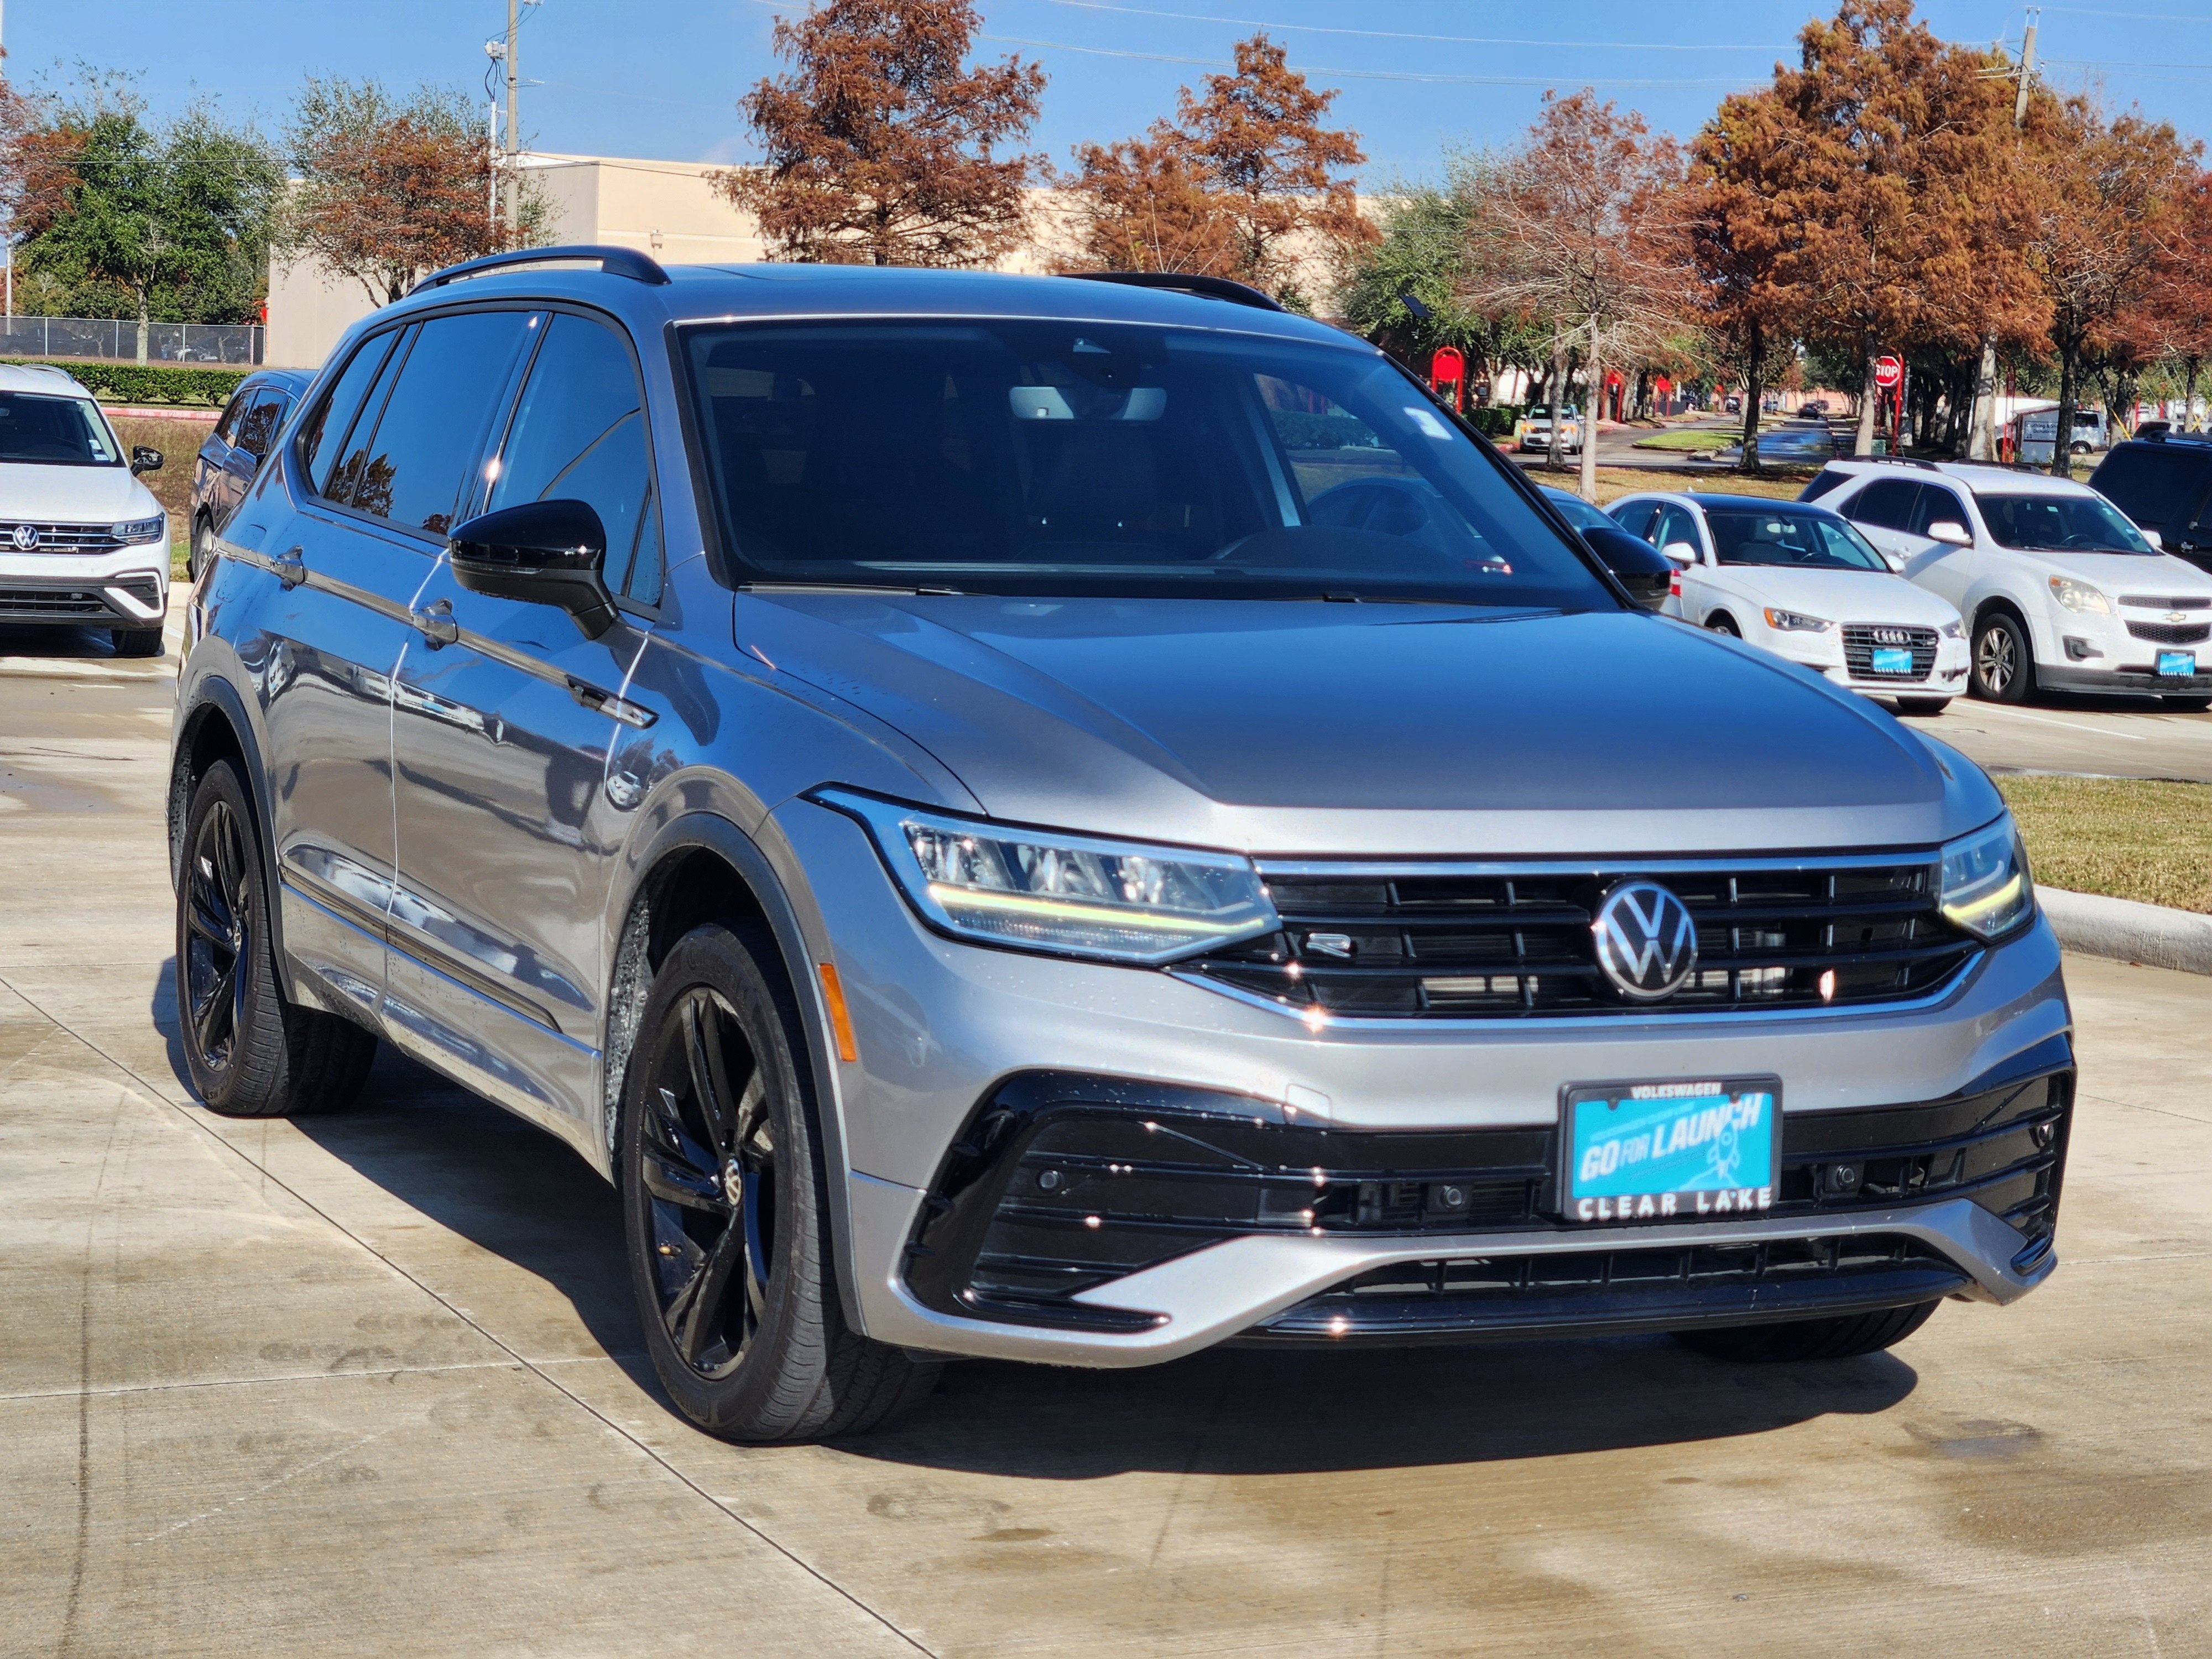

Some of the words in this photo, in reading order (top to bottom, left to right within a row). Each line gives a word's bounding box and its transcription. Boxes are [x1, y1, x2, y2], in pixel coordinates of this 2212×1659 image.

[1876, 364, 1898, 378] STOP
[1631, 1082, 1722, 1099] VOLKSWAGEN
[1579, 1140, 1621, 1183] GO
[1651, 1092, 1764, 1159] LAUNCH
[1578, 1193, 1677, 1220] CLEAR
[1696, 1187, 1772, 1214] LAKE
